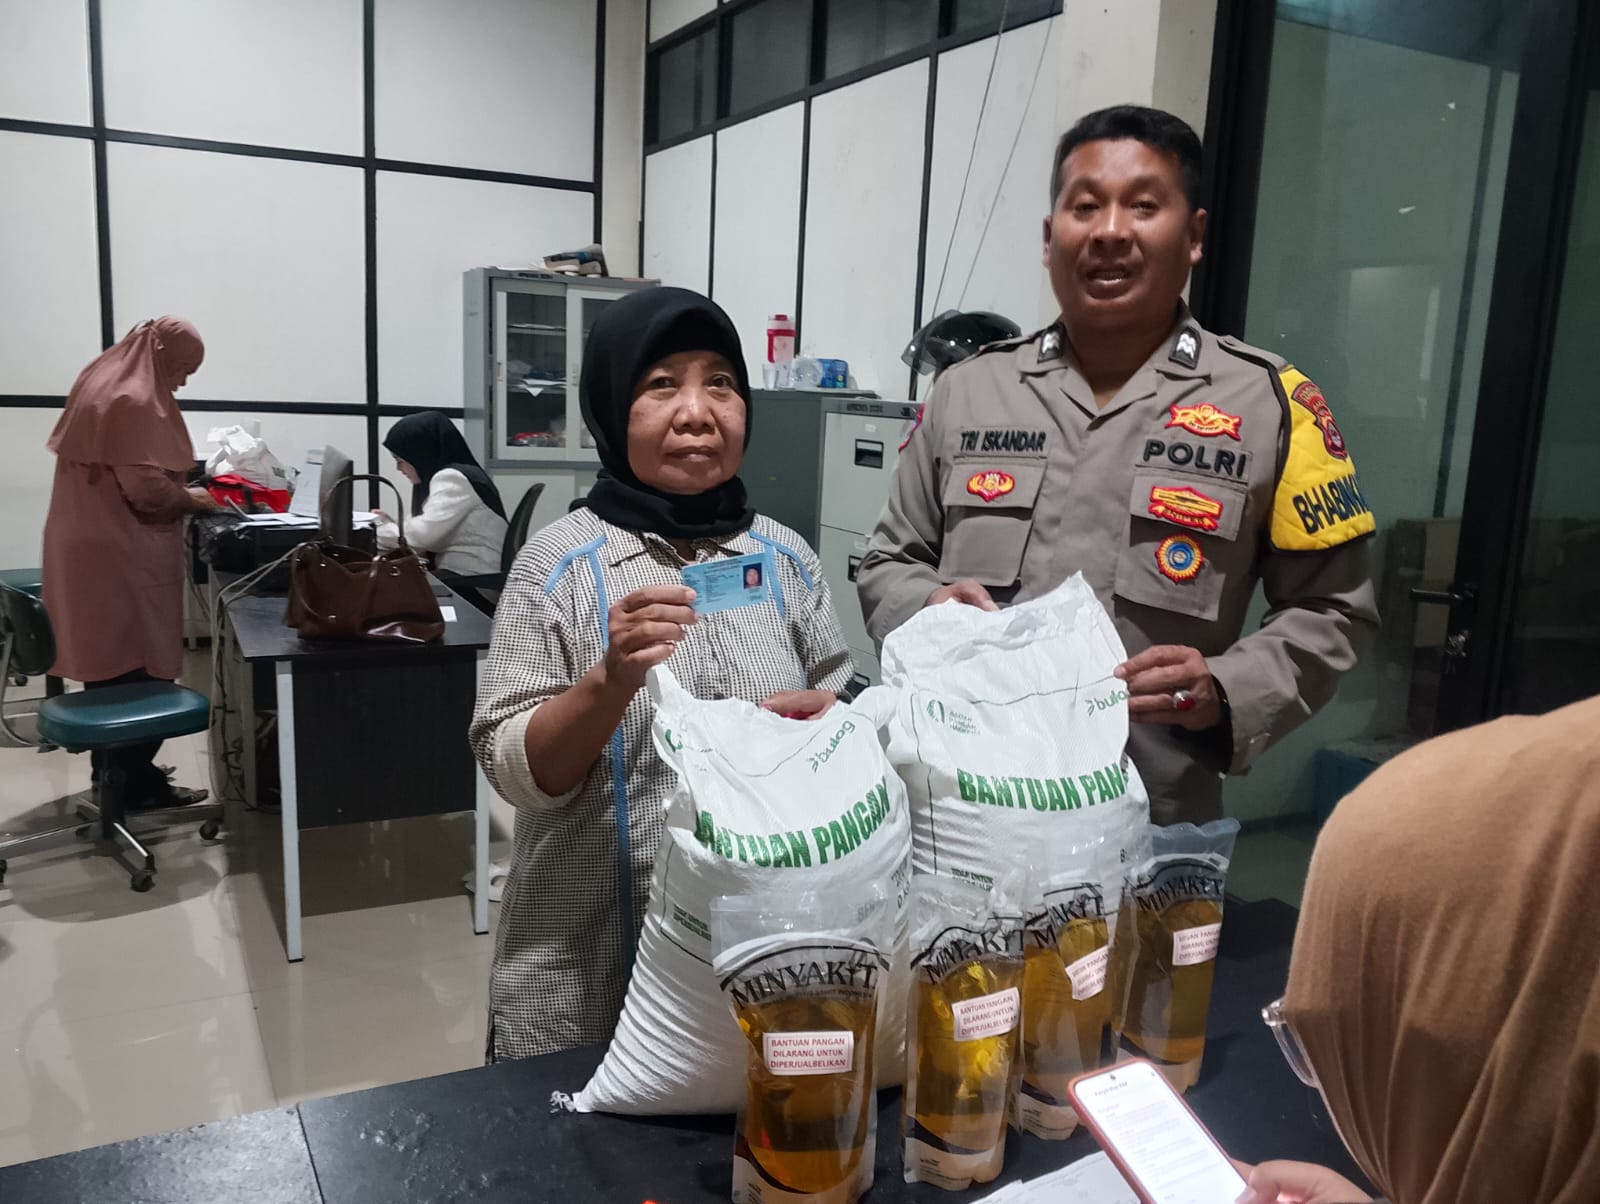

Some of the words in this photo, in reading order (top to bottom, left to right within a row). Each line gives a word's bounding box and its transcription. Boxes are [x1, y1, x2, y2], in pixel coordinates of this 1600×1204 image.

[961, 430, 980, 452] TRI
[981, 430, 1047, 452] ISKANDAR
[1143, 439, 1247, 478] POLRI
[1093, 689, 1128, 711] bulo
[956, 768, 1082, 812] BANTUAN
[1078, 761, 1129, 807] PAN
[694, 810, 813, 868] ANTUAN
[811, 776, 891, 865] PANGAN
[729, 961, 878, 1010] MINYAKIT
[771, 1039, 810, 1048] BANTUAN
[811, 1038, 846, 1047] PANGAN
[773, 1050, 815, 1058] DILARANG
[816, 1048, 844, 1057] UNTUK
[770, 1059, 847, 1069] DIPERJUALBELIKAN
